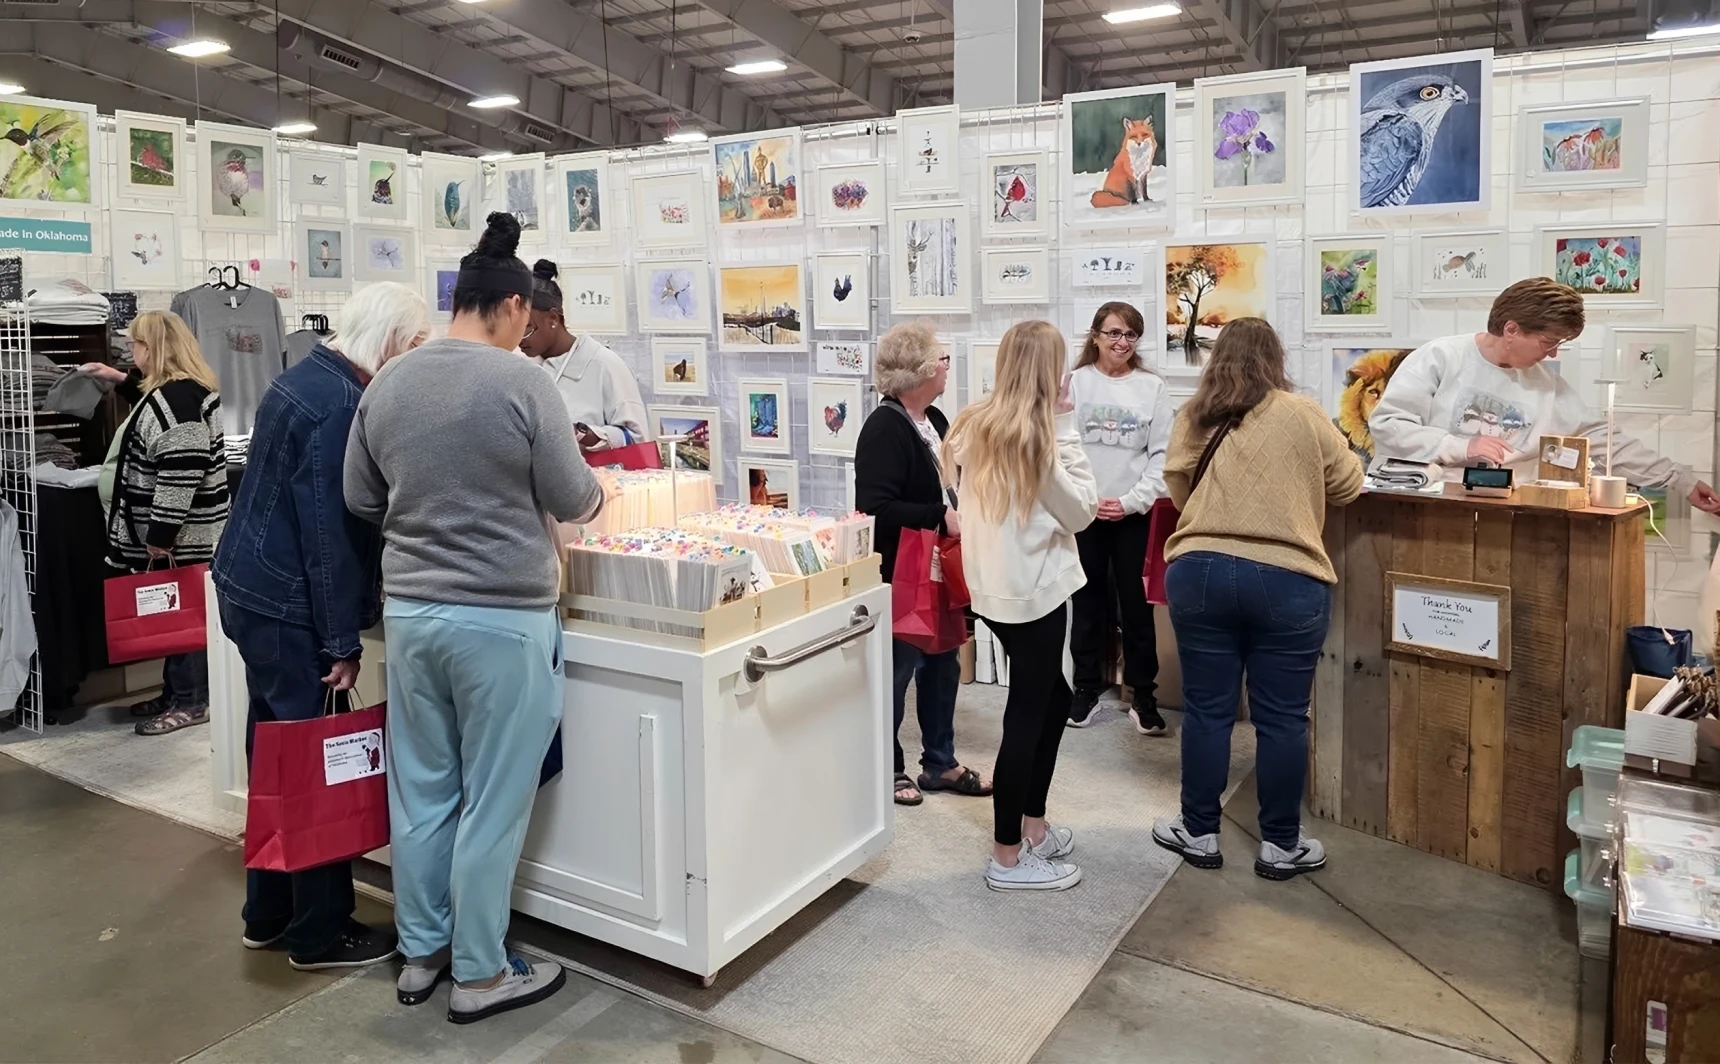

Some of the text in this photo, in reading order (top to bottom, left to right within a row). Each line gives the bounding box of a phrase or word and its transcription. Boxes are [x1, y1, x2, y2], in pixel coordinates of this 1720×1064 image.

[36, 230, 88, 242] Oklahoma
[1421, 596, 1452, 610] Thank
[1455, 601, 1472, 613] You
